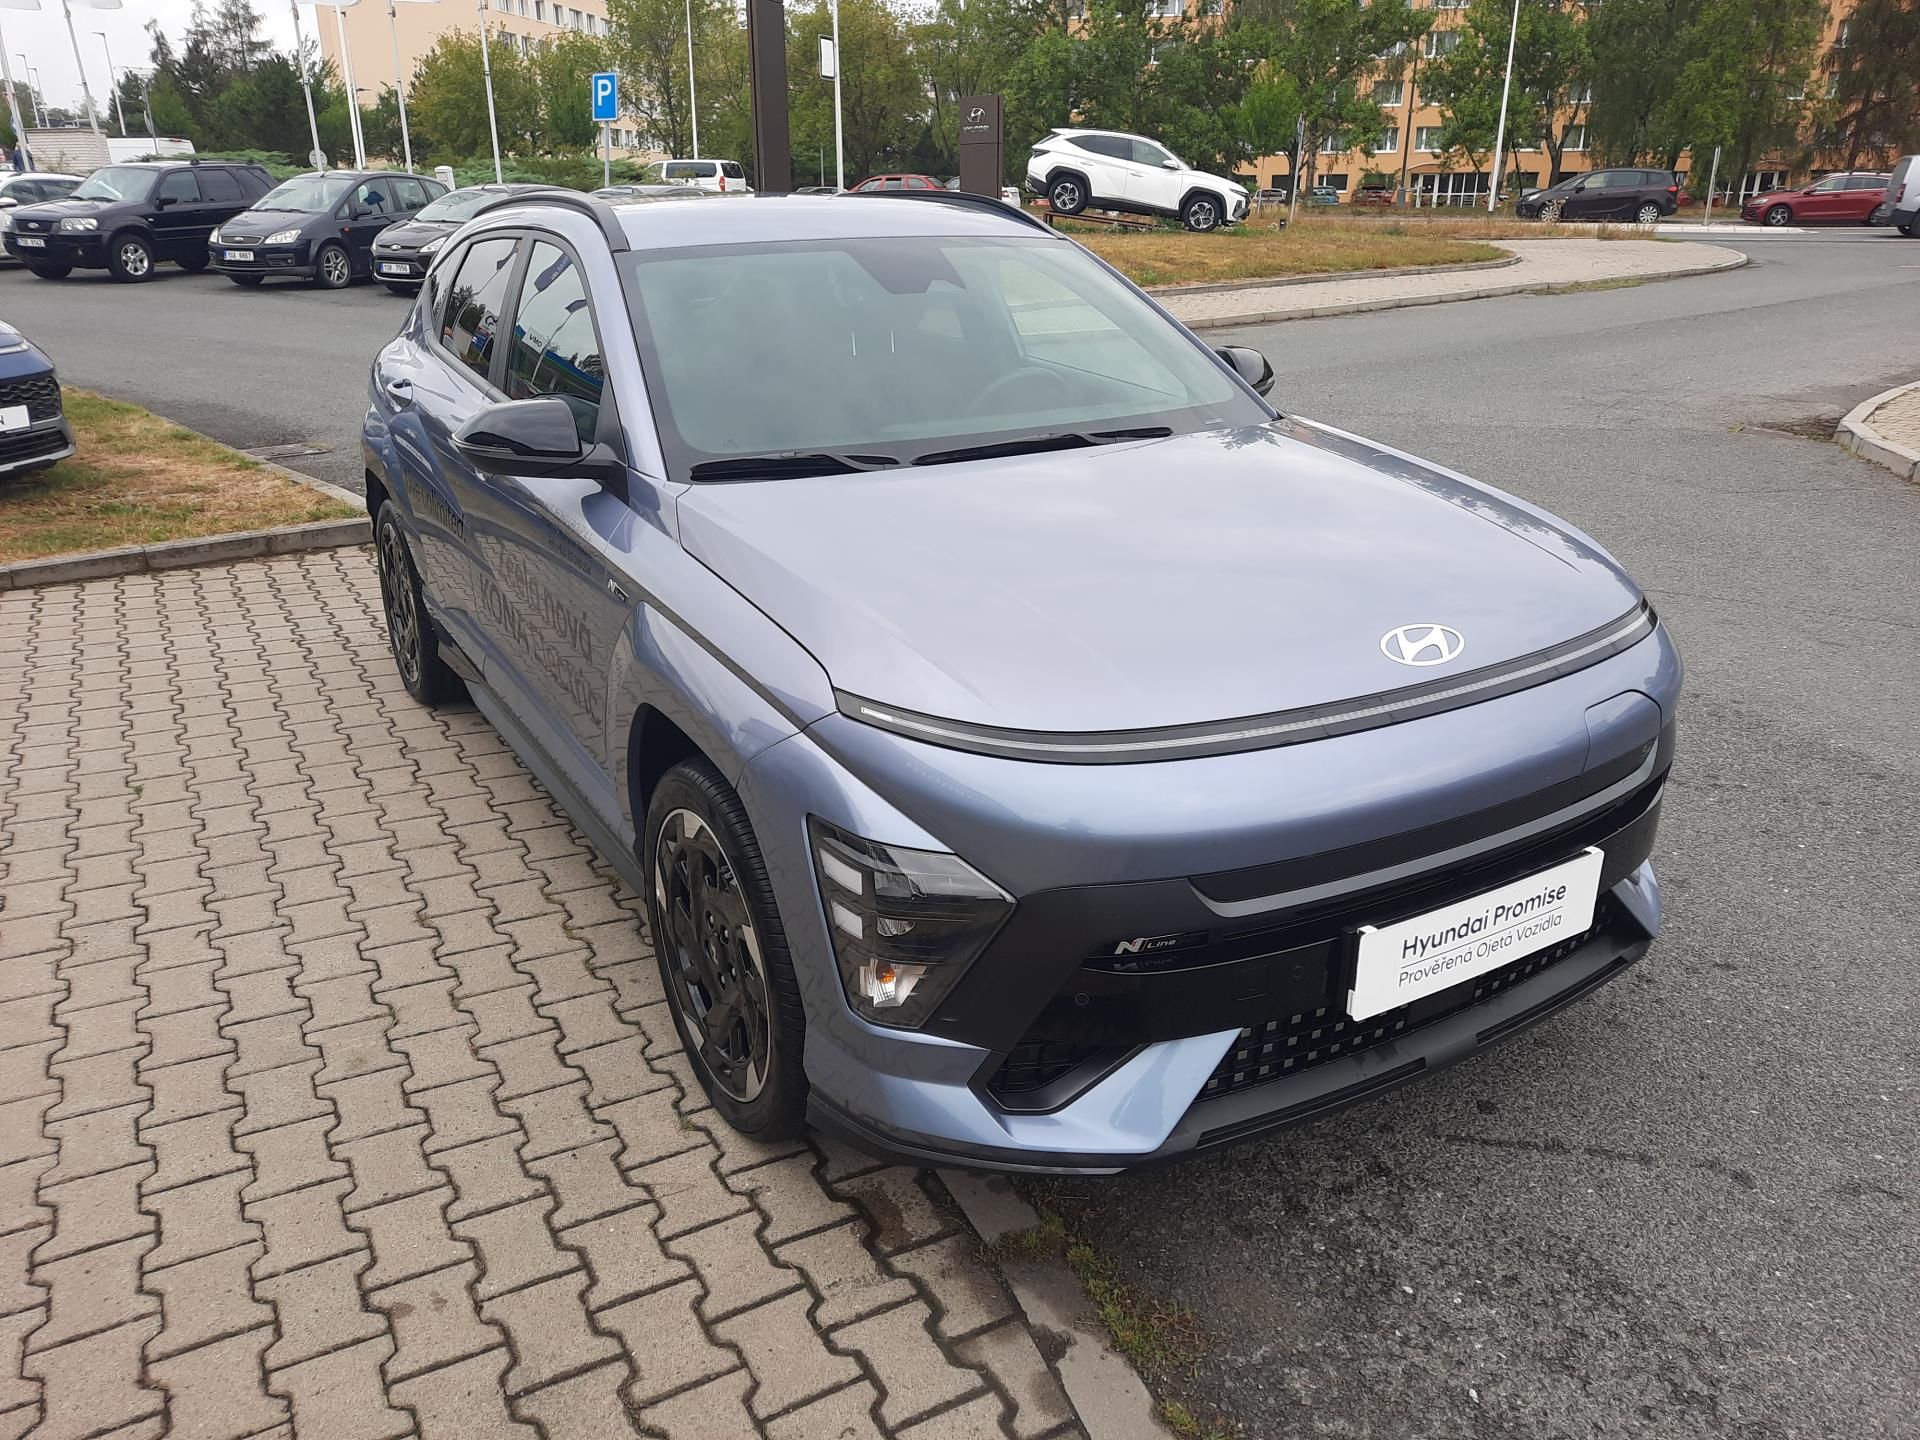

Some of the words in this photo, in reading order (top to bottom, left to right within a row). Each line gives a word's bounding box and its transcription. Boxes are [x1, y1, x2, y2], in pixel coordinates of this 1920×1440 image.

[597, 79, 612, 106] P
[479, 573, 530, 656] KONA
[1147, 938, 1177, 949] Line
[1398, 946, 1473, 988] Prověřená
[1476, 930, 1513, 958] Ojetá
[1516, 911, 1562, 944] Vozidla
[1401, 909, 1489, 960] Hyundai
[1493, 884, 1567, 926] Promise
